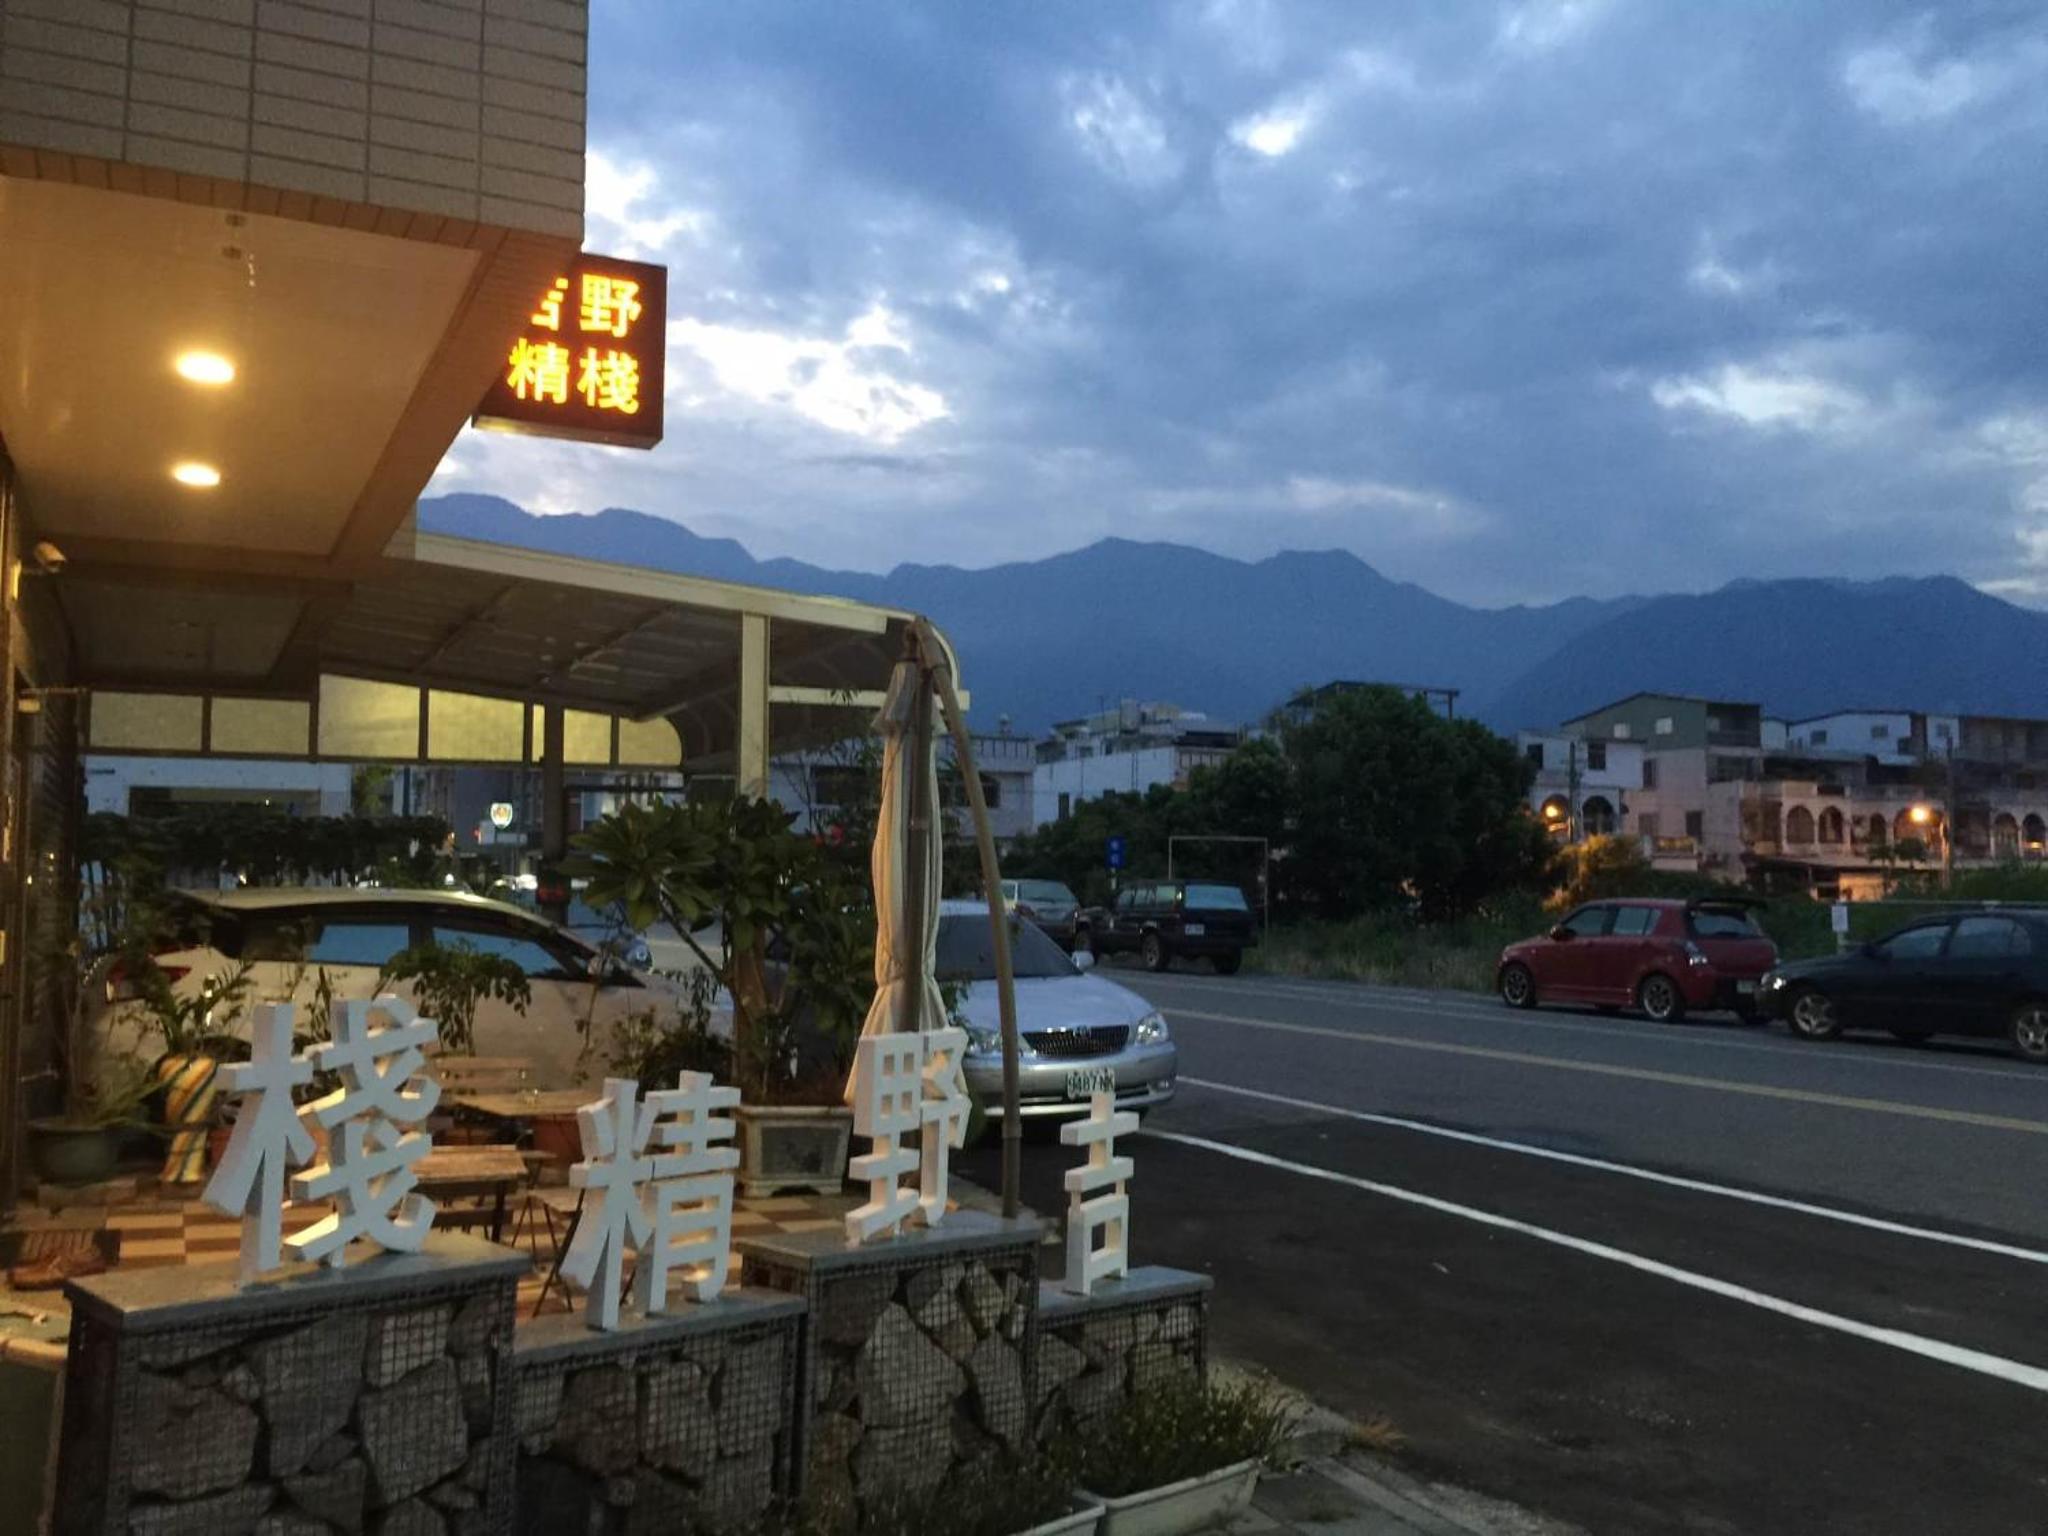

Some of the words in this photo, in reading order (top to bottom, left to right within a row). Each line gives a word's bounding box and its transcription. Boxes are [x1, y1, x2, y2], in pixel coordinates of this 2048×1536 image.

[558, 1069, 742, 1331] 精
[845, 1026, 973, 1248] 野
[1060, 1091, 1140, 1296] 吉
